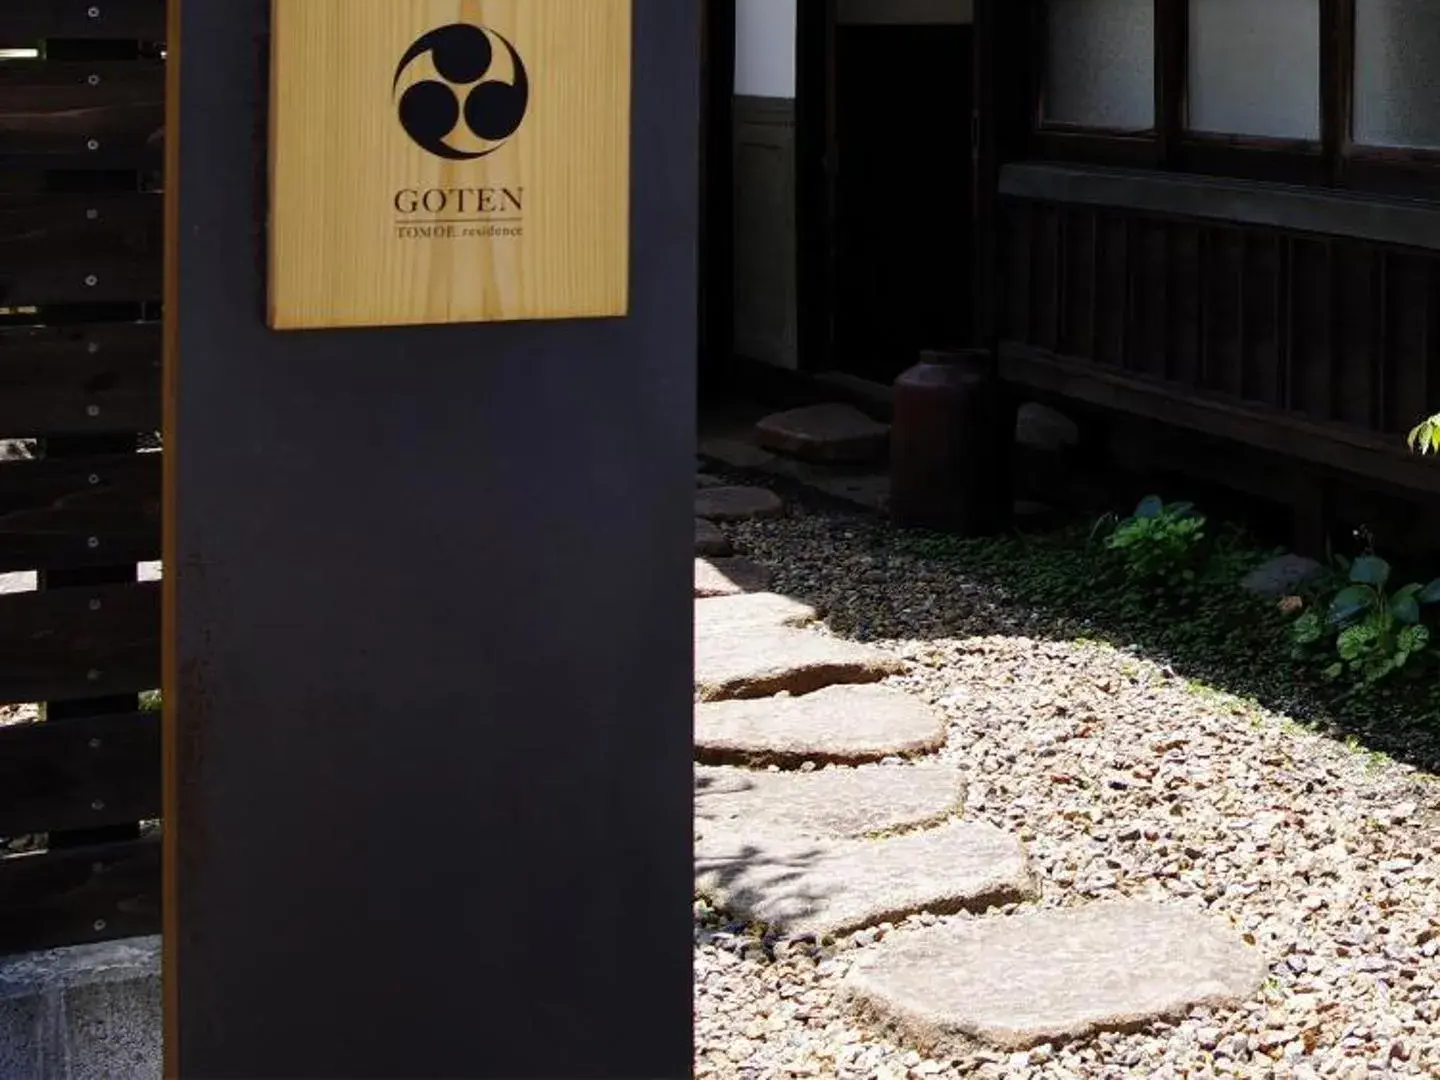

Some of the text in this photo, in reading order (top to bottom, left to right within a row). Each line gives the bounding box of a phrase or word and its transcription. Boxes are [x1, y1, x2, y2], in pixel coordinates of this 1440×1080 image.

[394, 186, 523, 213] GOTEN
[396, 224, 523, 238] TOMOE residence
